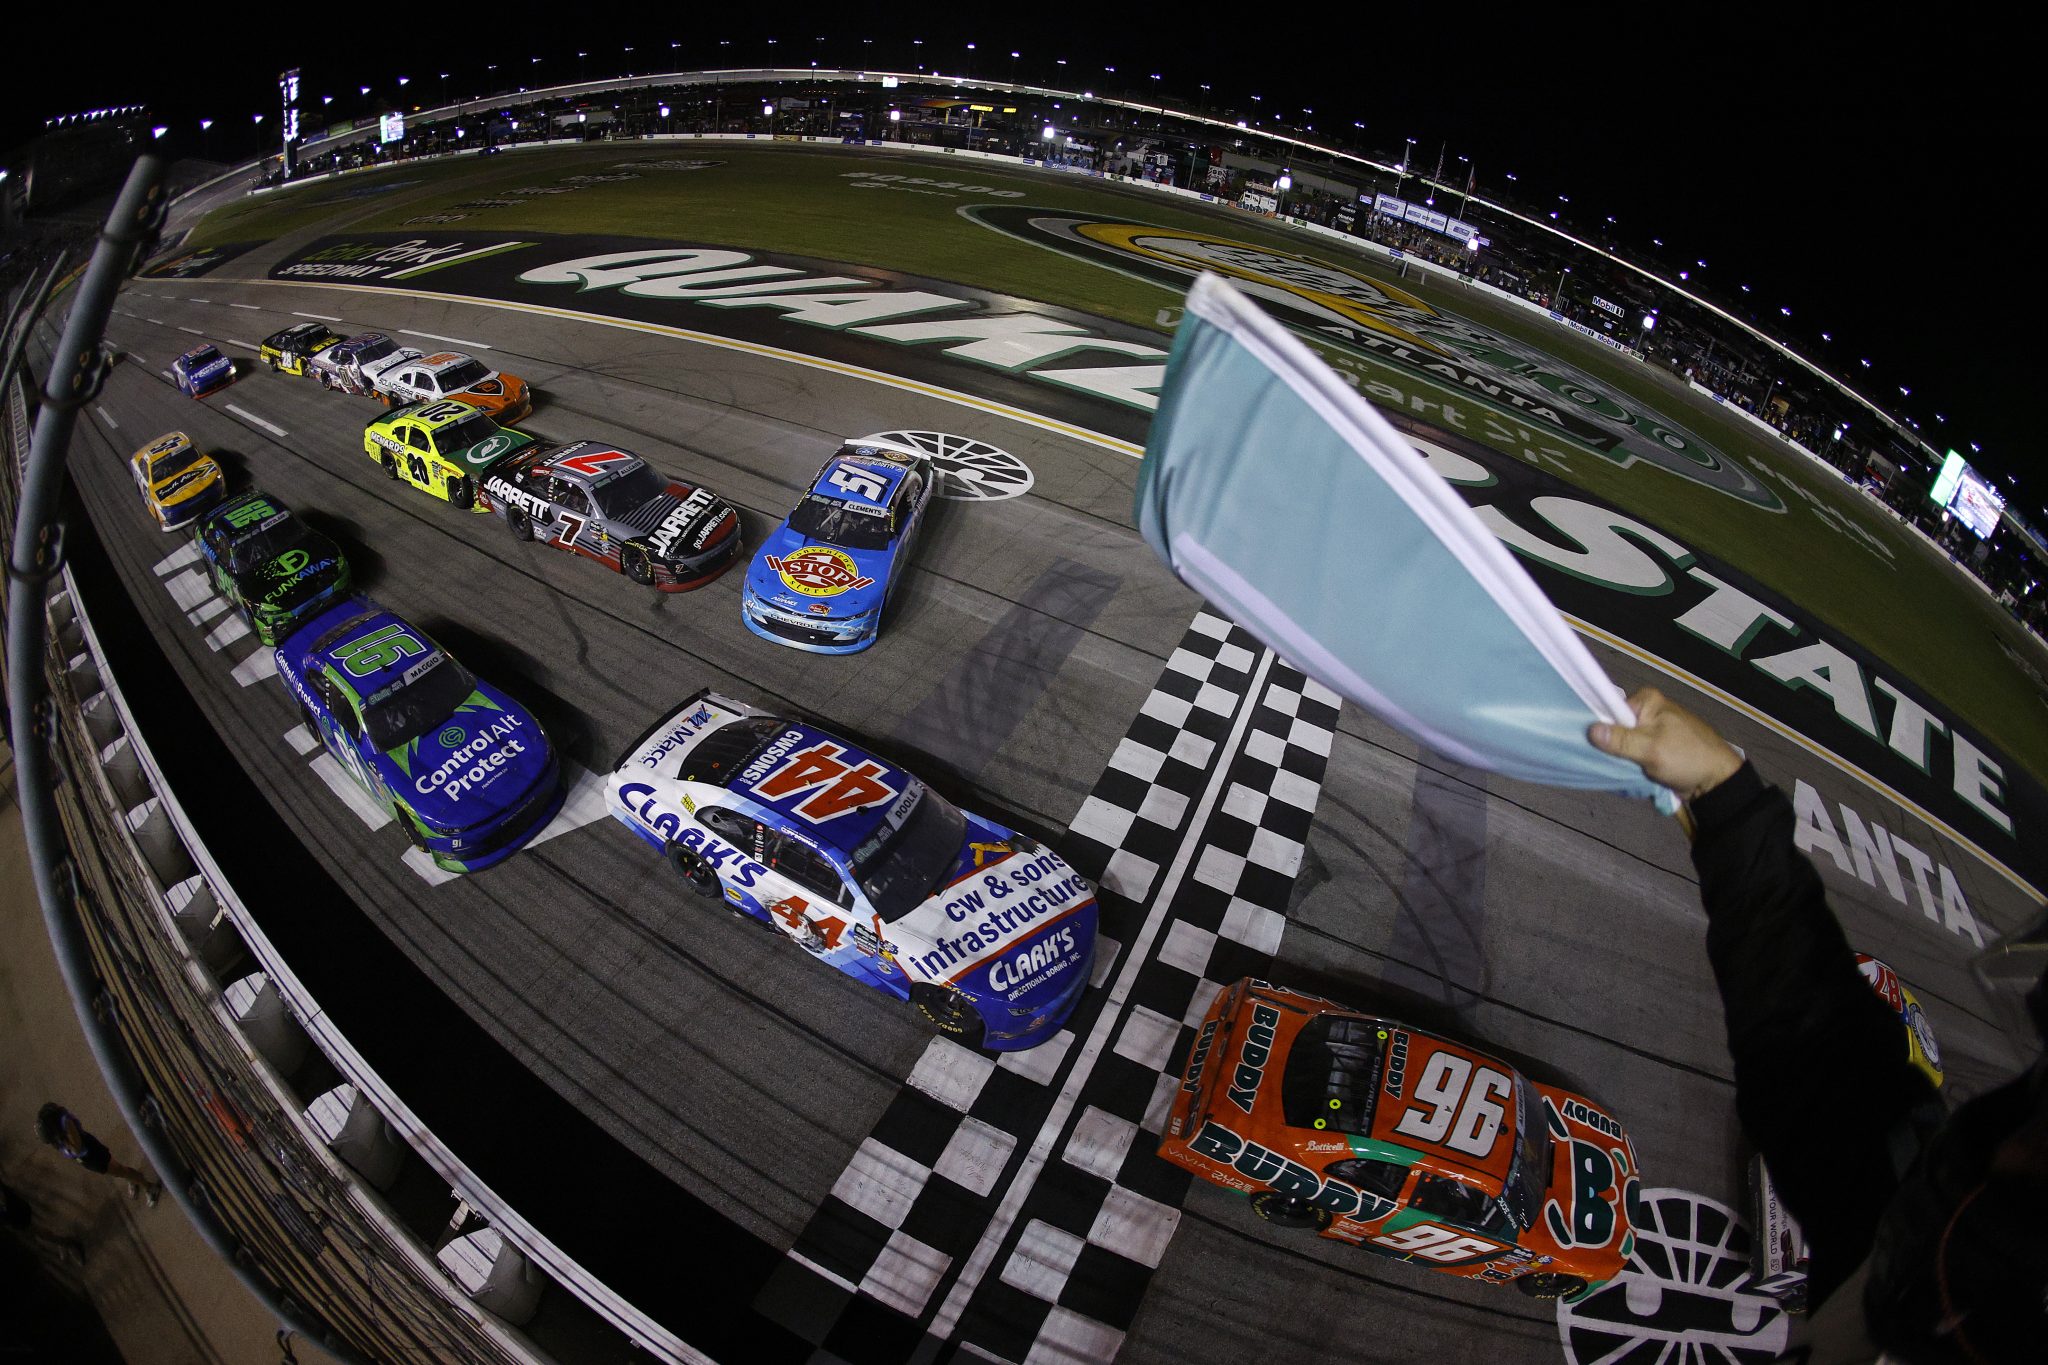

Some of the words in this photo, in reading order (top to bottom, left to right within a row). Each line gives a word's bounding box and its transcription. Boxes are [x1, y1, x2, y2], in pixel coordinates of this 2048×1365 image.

[277, 263, 391, 278] SPEEDWAY
[1593, 296, 1616, 313] Mobil
[1616, 306, 1624, 317] 1
[1569, 320, 1588, 334] Mobil
[1587, 328, 1595, 337] 1
[1597, 334, 1615, 347] Mobil
[1614, 341, 1622, 350] 1
[1326, 323, 1567, 427] ATLANTA
[416, 402, 468, 423] 20
[370, 430, 406, 455] MENARDS
[543, 441, 590, 467] JARRETT
[553, 449, 634, 477] 7
[406, 452, 431, 486] 20
[619, 460, 644, 475] ALLGAIER
[829, 463, 891, 502] 51
[484, 474, 552, 520] JARRETT
[848, 502, 883, 517] CLEMENTS
[558, 510, 586, 547] 7
[648, 486, 717, 559] JARRETT
[265, 558, 338, 602] FUNKAWAY
[789, 560, 852, 584] STOP
[769, 613, 831, 632] CHEVROLET
[410, 656, 440, 679] MAGGIO
[1473, 495, 2015, 838] STATE
[297, 682, 322, 718] Protect
[643, 725, 695, 770] Macc
[743, 730, 804, 787] CWSONS
[443, 737, 526, 803] Protect
[749, 739, 899, 825] 44
[894, 790, 919, 821] POOLE
[618, 782, 769, 889] CLARK'S
[1793, 778, 1985, 949] ANTA
[944, 889, 987, 923] cw
[983, 874, 1015, 900] &
[1010, 850, 1067, 887] sons
[770, 895, 848, 952] 44
[908, 872, 1089, 981] infrastructure
[988, 926, 1076, 992] CLARK'S
[1008, 974, 1047, 1002] DIRECTIONAL
[1182, 1019, 1219, 1093] BUDDY
[1227, 1002, 1281, 1114] BUDDY
[1383, 1027, 1410, 1101] BUDDY
[1361, 1056, 1382, 1136] CHEVROLET
[1394, 1050, 1512, 1161] 96
[1169, 1115, 1182, 1136] 96
[1561, 1097, 1624, 1142] BUDDY
[1186, 1119, 1399, 1224] BUDDY
[1768, 1197, 1777, 1222] YOUR
[1371, 1223, 1502, 1264] 96
[1769, 1223, 1779, 1255] WORLD
